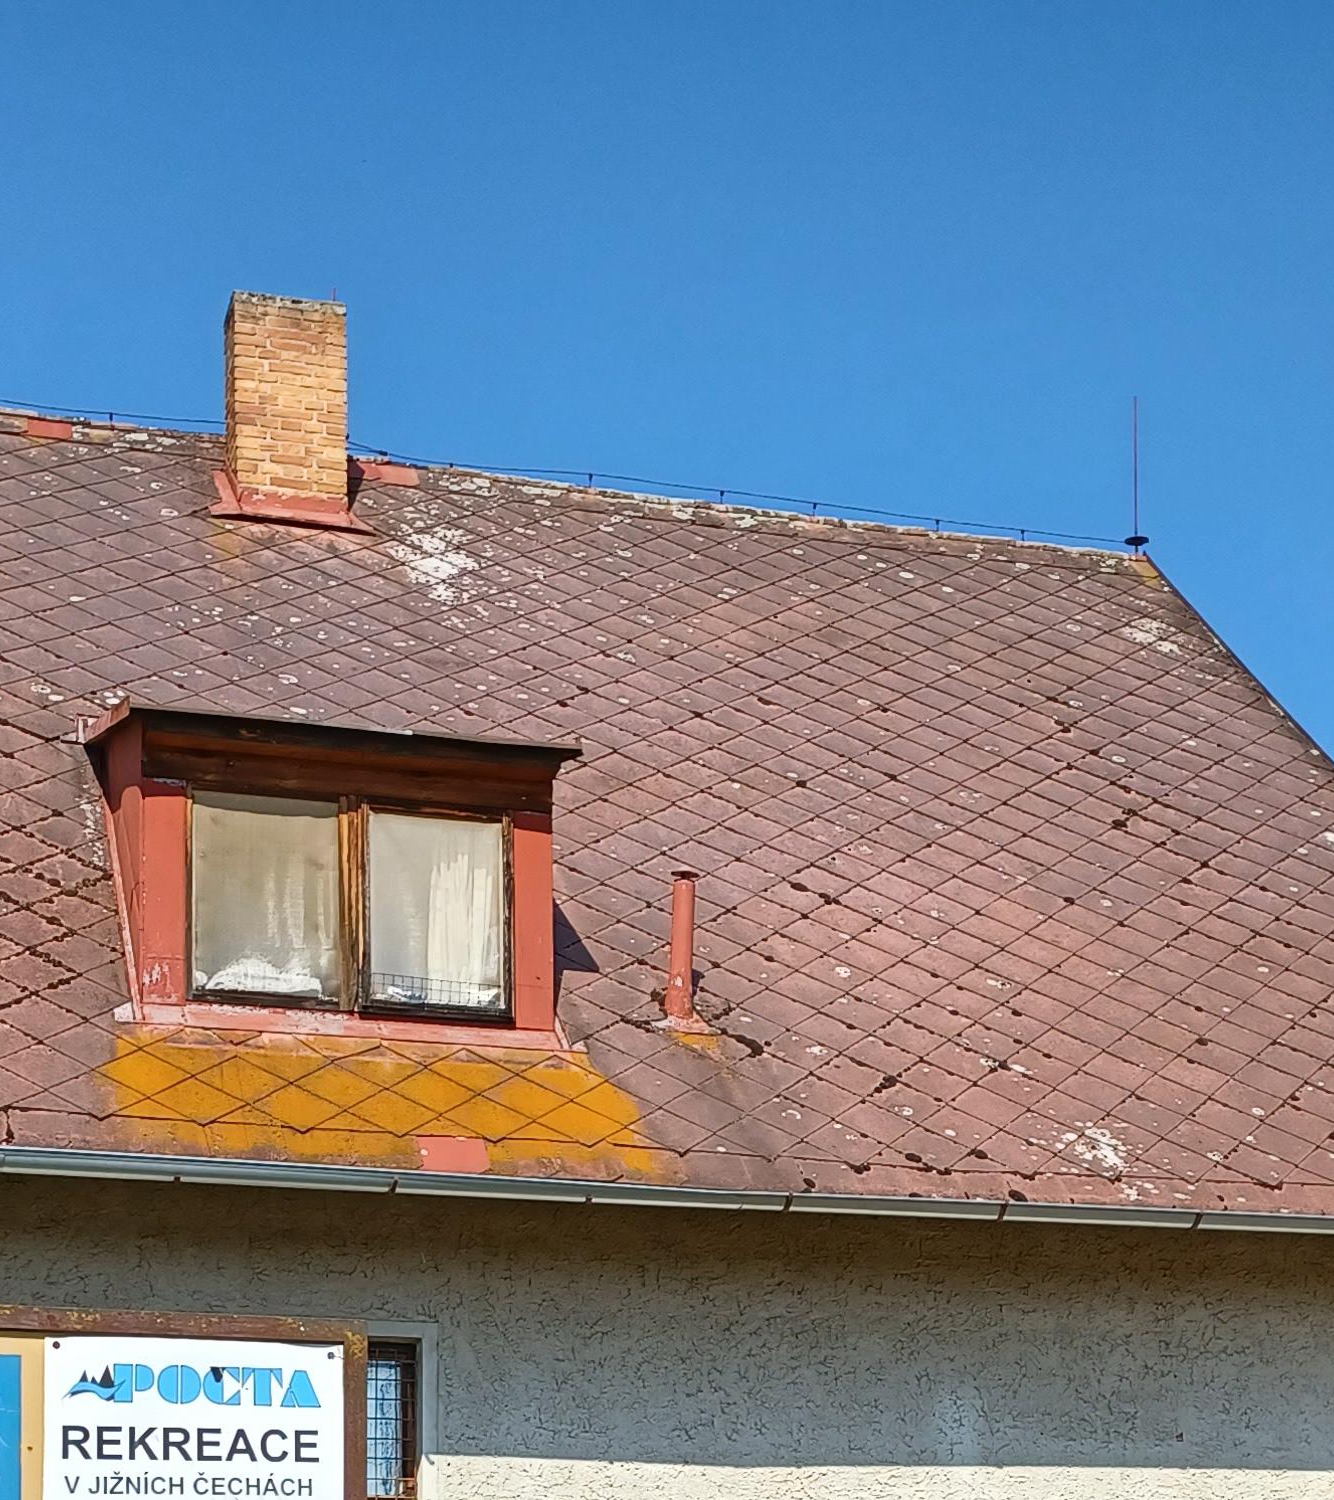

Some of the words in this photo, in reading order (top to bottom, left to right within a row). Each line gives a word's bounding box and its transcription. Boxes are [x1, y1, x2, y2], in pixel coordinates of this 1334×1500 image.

[113, 1363, 321, 1408] POČTA
[62, 1425, 319, 1462] REKREACE
[63, 1475, 81, 1495] V
[88, 1471, 184, 1495] JIŽNÍCH
[193, 1472, 312, 1496] ČECHÁCH
